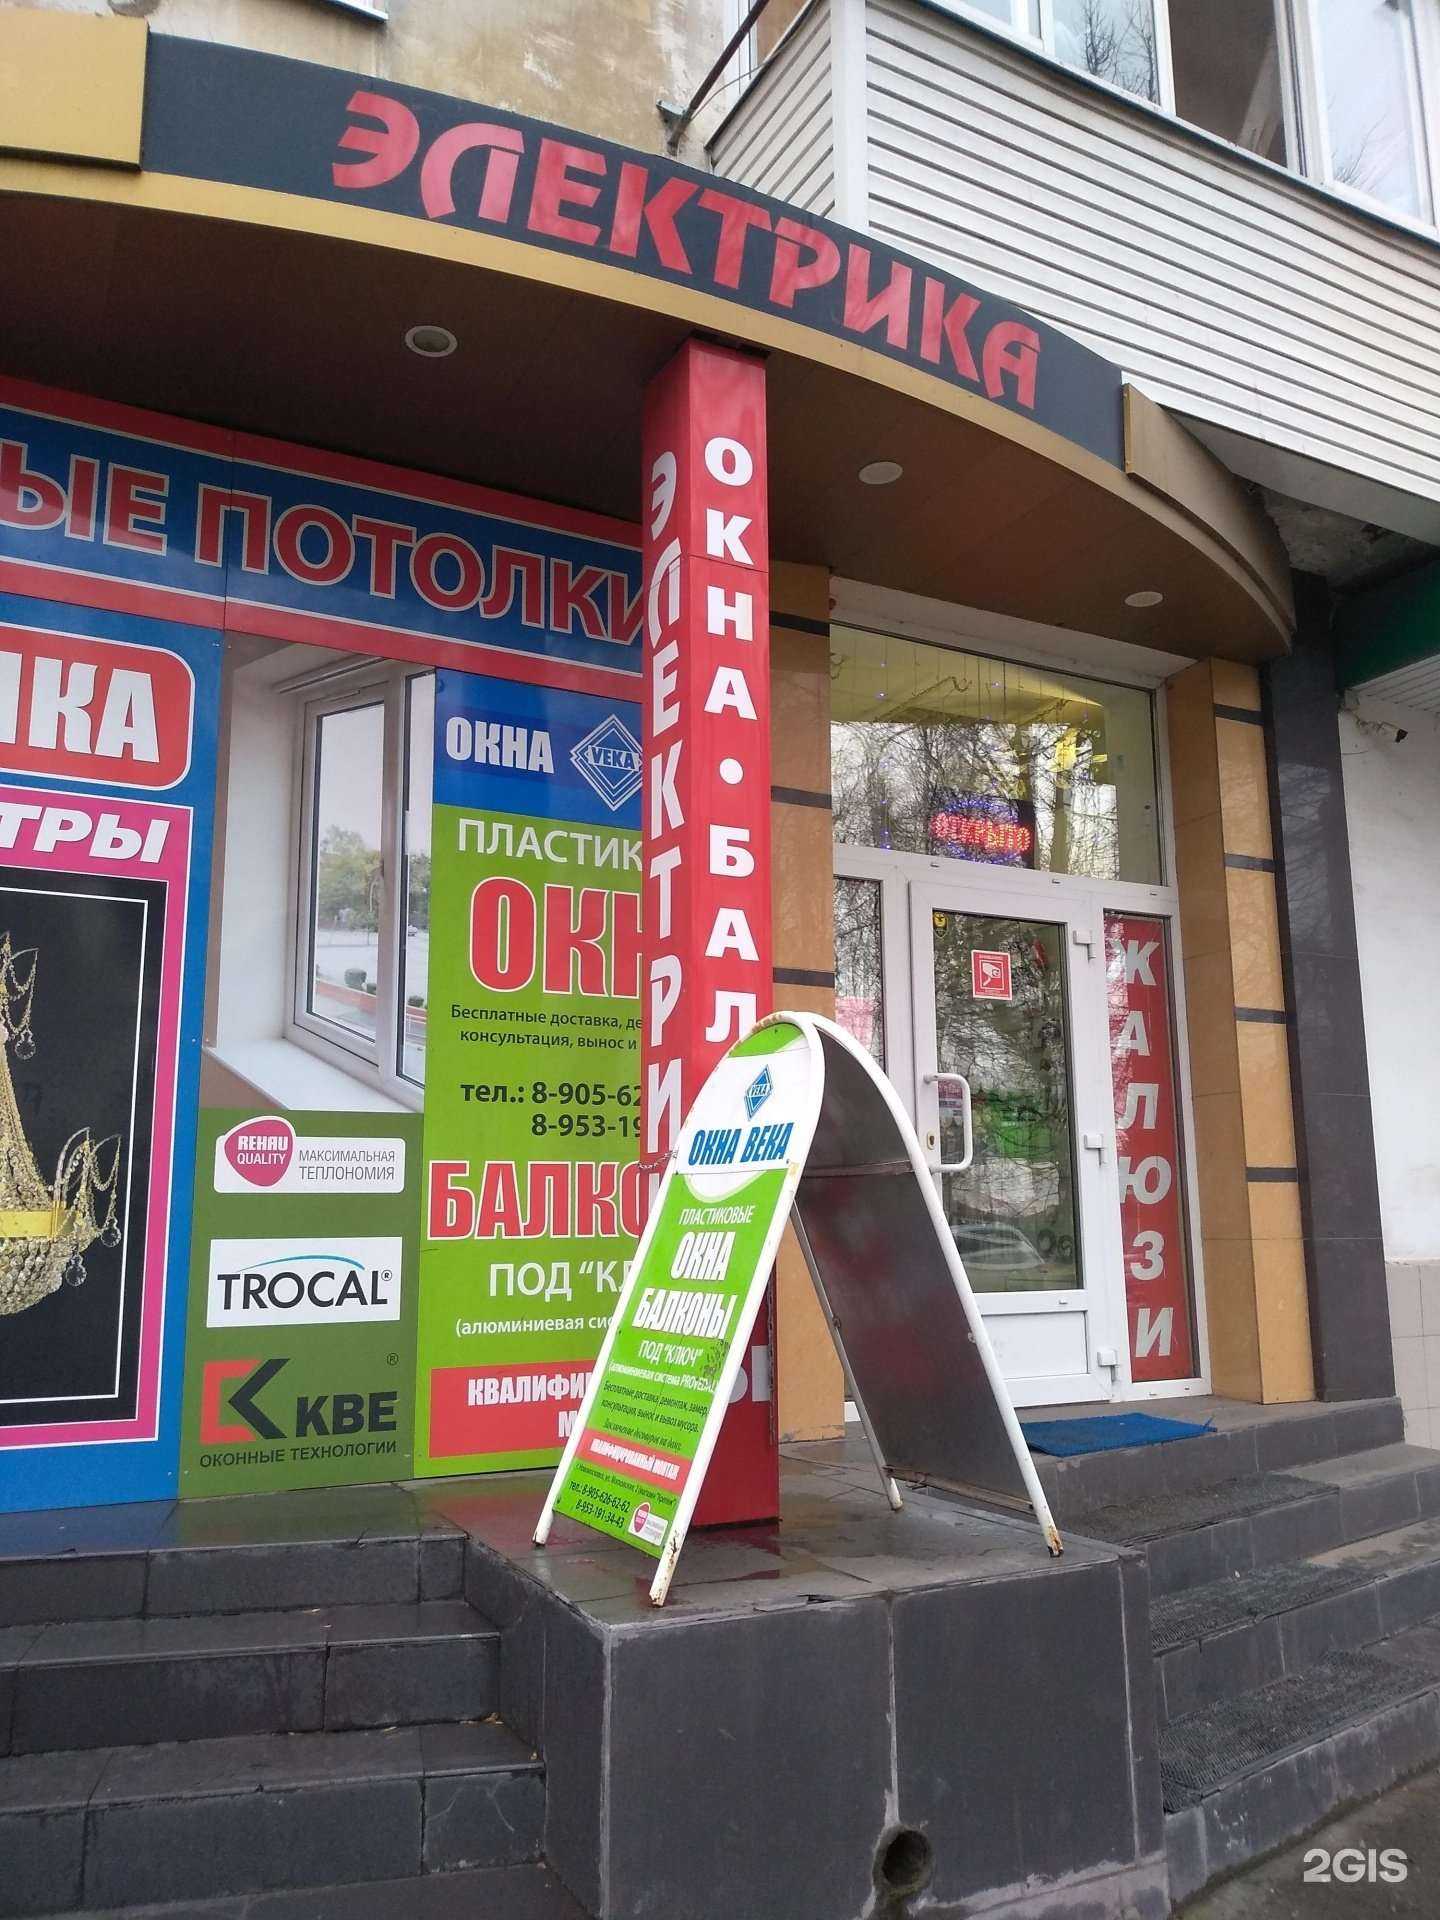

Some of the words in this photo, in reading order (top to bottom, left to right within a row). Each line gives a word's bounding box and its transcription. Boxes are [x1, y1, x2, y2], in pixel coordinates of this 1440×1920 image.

[331, 91, 1042, 409] ЭЛЕКТРИКА
[703, 437, 758, 720] ОКНА
[0, 651, 160, 763] КА
[445, 716, 554, 774] ОКНА
[591, 747, 635, 771] VEKA
[930, 811, 1031, 852] ОТКРЫТО
[451, 1004, 547, 1024] Бесплатные
[550, 1013, 622, 1030] доставка,
[460, 1030, 573, 1049] консультация,
[577, 1036, 625, 1049] вынос
[628, 1040, 637, 1050] и
[460, 1083, 525, 1104] тел.:
[237, 1134, 289, 1152] REHAU
[298, 1149, 396, 1163] МАКСИМАЛЬНАЯ
[688, 1127, 742, 1166] ОКНА
[740, 1122, 795, 1163] ВЕКА
[1108, 938, 1174, 1358] ЖАЛЮЗИ
[236, 1152, 287, 1166] QUALITY
[298, 1165, 396, 1182] ТЕПЛОНОМИЯ
[679, 1205, 755, 1226] ПЛАСТИКОВЫЕ
[670, 1231, 737, 1281] ОКНА
[489, 1262, 573, 1302] ПОД
[456, 1317, 584, 1338] (алюминиевая
[632, 1287, 739, 1340] БАЛКОНЫ
[638, 1340, 664, 1366] ПОД
[295, 1390, 398, 1439] KBE
[200, 1448, 285, 1468] ОКОННЫЕ
[290, 1439, 397, 1462] ТЕХНОЛОГИИ
